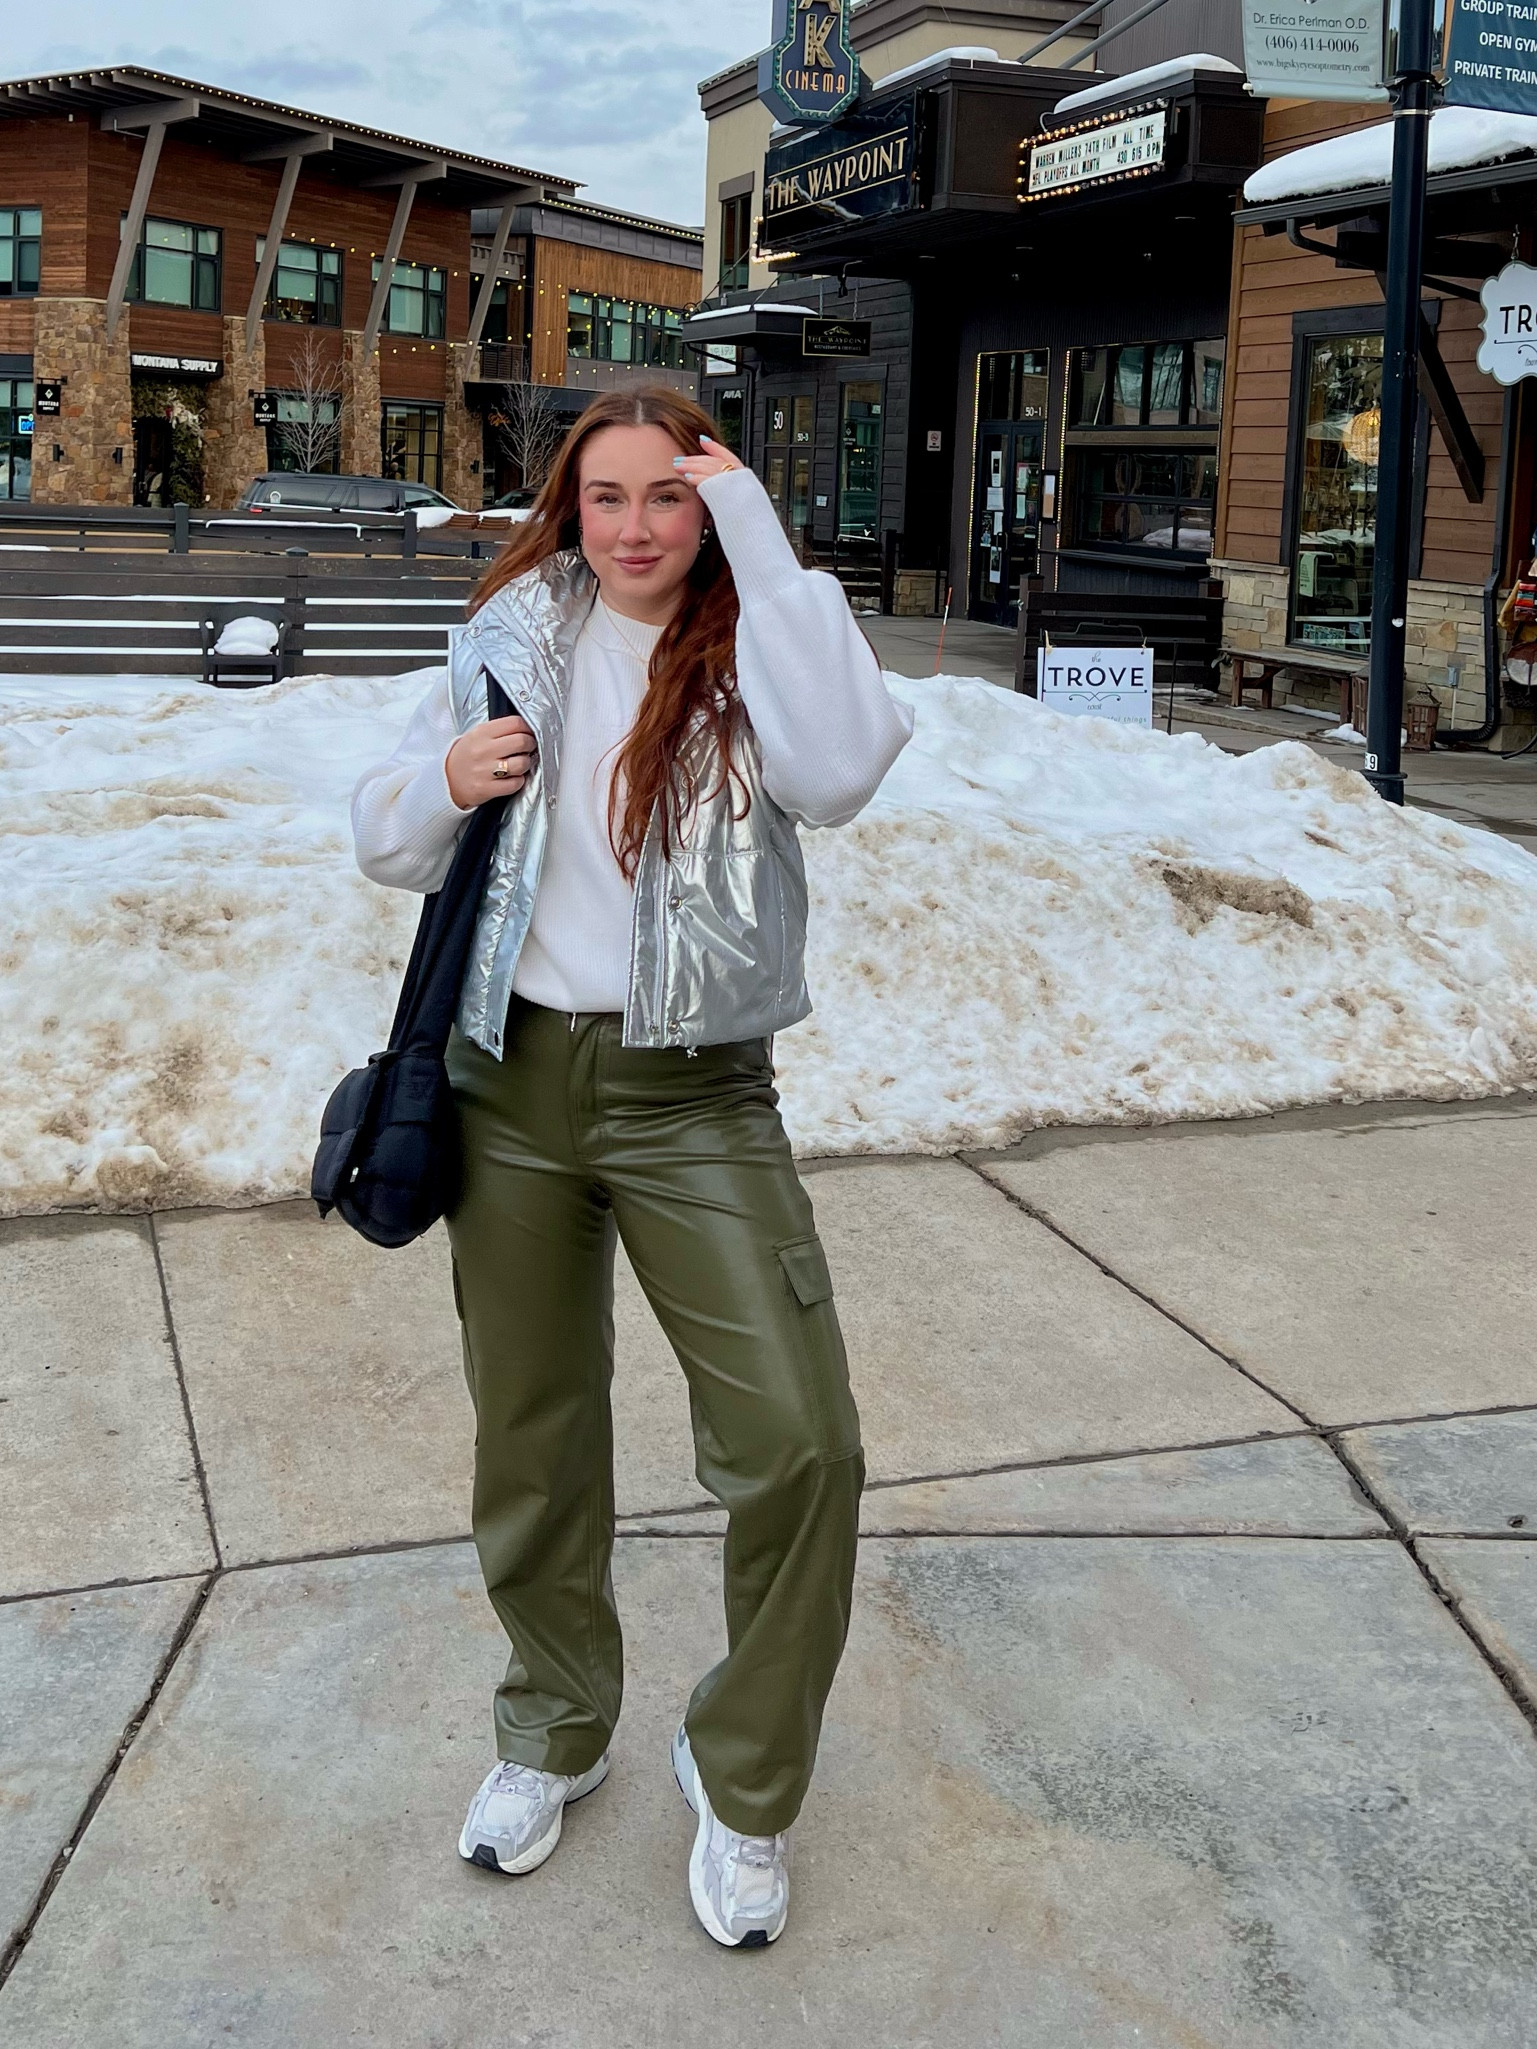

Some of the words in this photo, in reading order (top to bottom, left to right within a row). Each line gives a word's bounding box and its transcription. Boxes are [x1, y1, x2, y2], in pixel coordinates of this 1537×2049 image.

[1461, 0, 1504, 15] GROUP
[1253, 12, 1267, 24] Dr.
[1270, 13, 1296, 26] Erica
[1299, 15, 1342, 28] Perlman
[1345, 17, 1370, 30] O.D.
[1265, 34, 1298, 52] (406)
[1300, 36, 1360, 53] 414-0006
[1479, 31, 1512, 49] OPEN
[1256, 57, 1370, 75] www.bigskyeyesoptometry.com
[1454, 60, 1502, 80] PRIVATE
[785, 69, 846, 94] CINEMA
[1035, 152, 1056, 169] WARREN
[1058, 144, 1082, 163] MILLERS
[1085, 139, 1100, 156] 74TH
[1102, 134, 1117, 151] FILM
[1123, 129, 1133, 145] ALL
[1139, 124, 1155, 142] TIME
[767, 174, 800, 211] THE
[807, 137, 909, 199] WAYPOINT
[1044, 165, 1069, 184] PLAYOFFS
[1070, 161, 1080, 177] ALL
[1082, 157, 1100, 173] MONTH
[1117, 149, 1128, 164] 430
[1131, 146, 1142, 162] 615
[1499, 304, 1537, 335] TR
[132, 354, 179, 370] MONTANA
[180, 359, 218, 373] SUPPLY
[774, 411, 783, 430] 50
[1025, 406, 1041, 417] 50-1
[1047, 666, 1144, 687] TROVE
